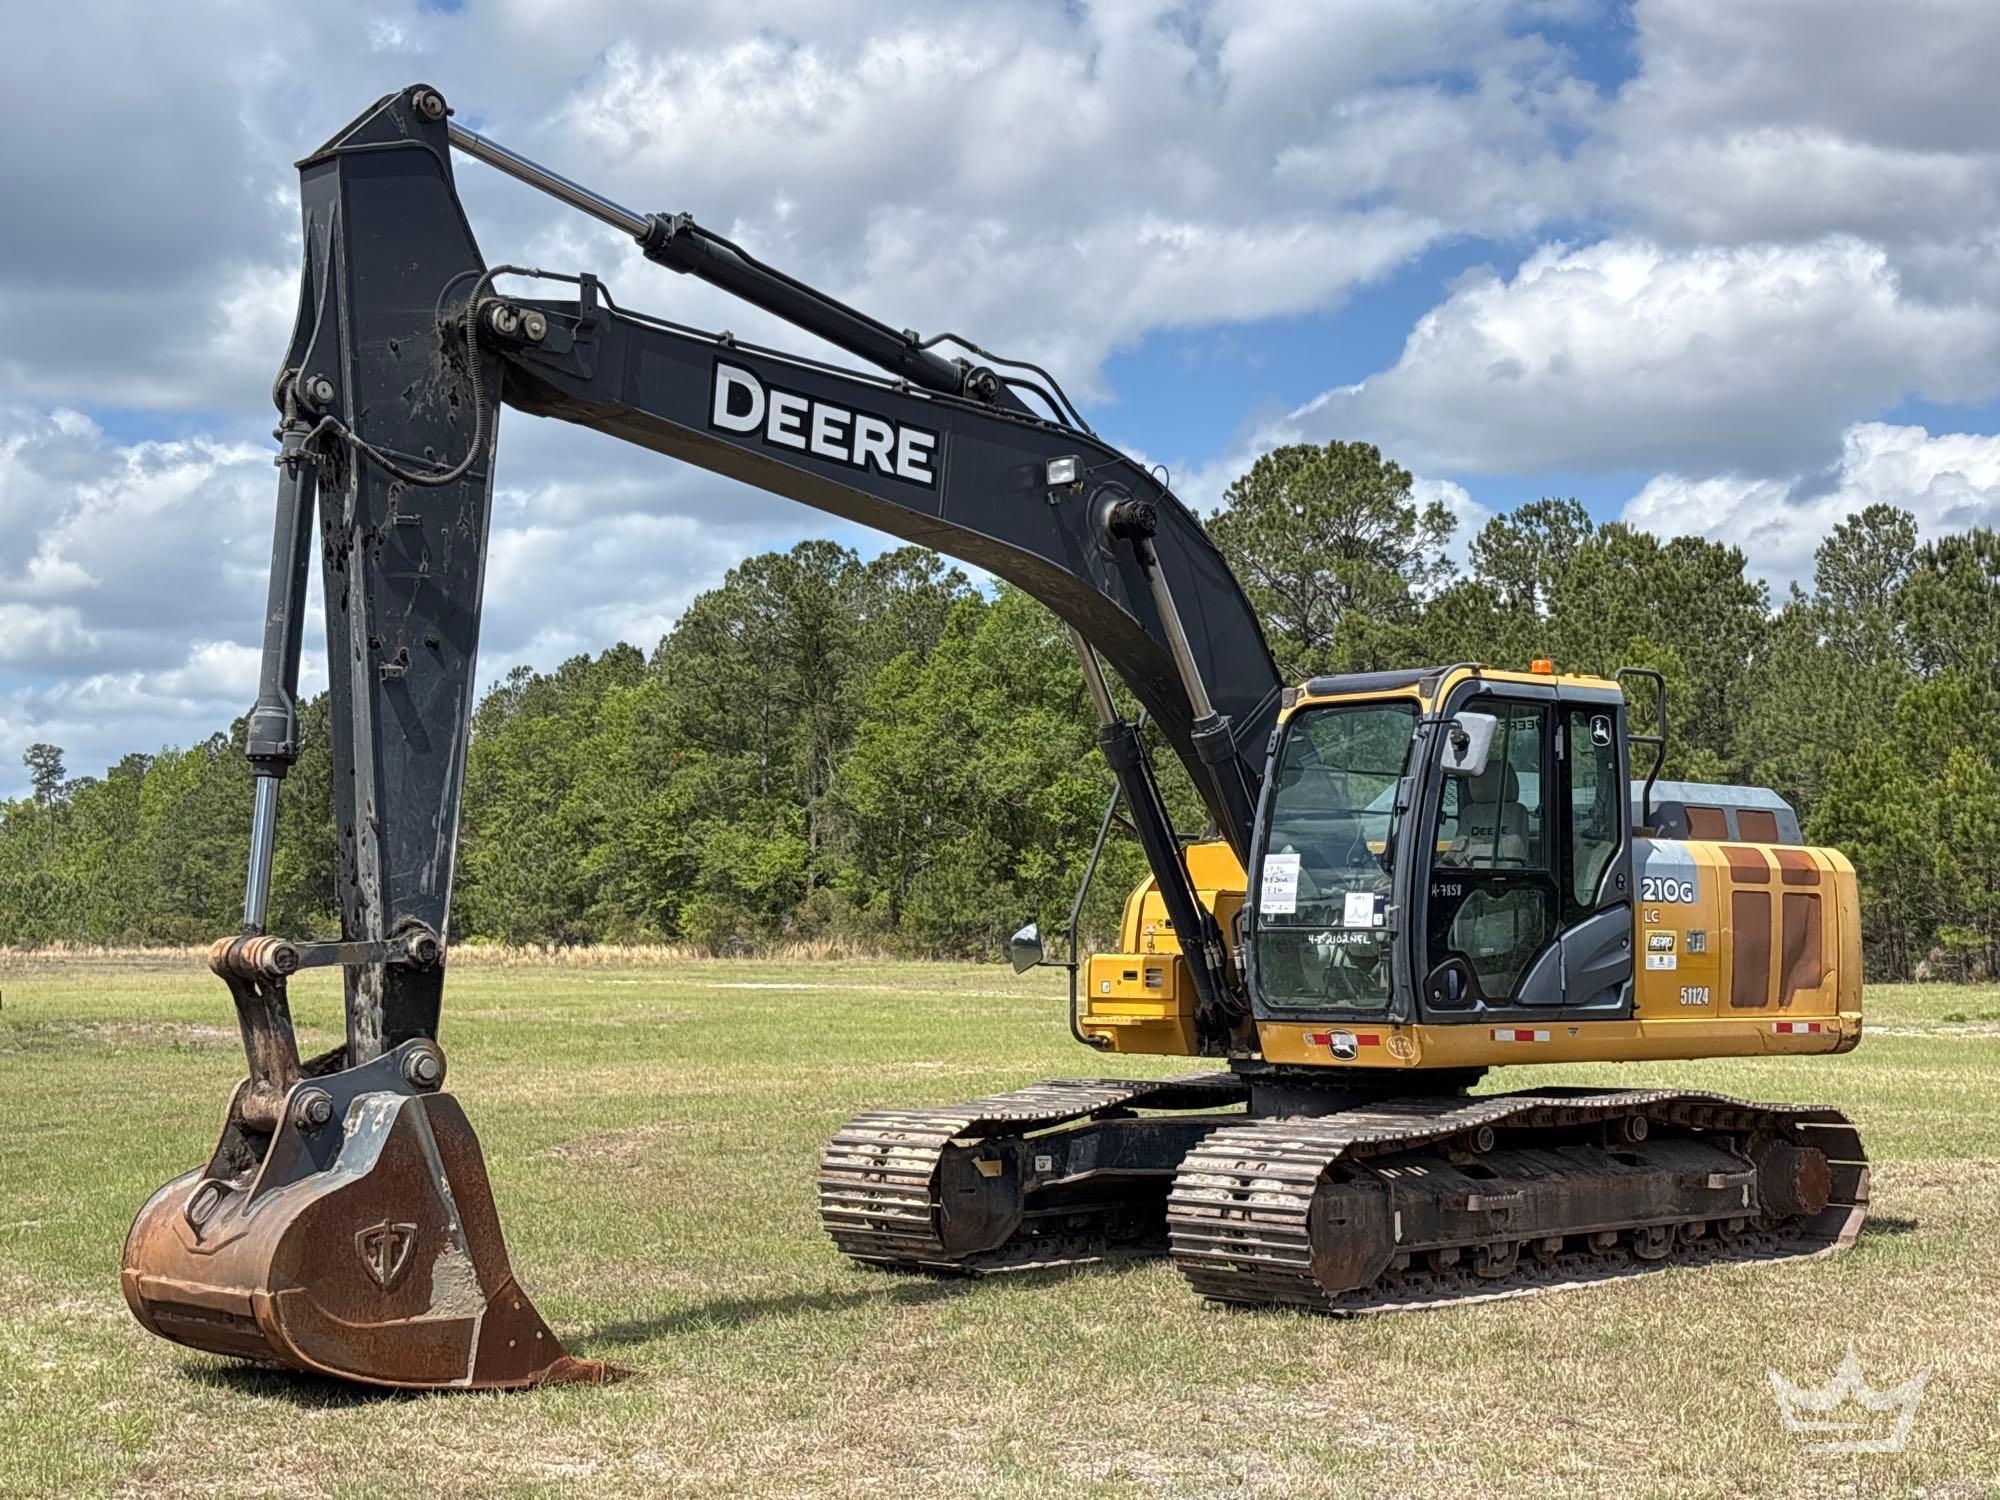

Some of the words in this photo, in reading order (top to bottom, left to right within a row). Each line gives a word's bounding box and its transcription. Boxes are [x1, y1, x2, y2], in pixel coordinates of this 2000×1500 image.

[712, 361, 936, 485] DEERE
[1471, 826, 1507, 836] DEEE
[1641, 876, 1694, 904] 210G
[1644, 909, 1660, 924] LC
[1680, 986, 1710, 1006] 51124
